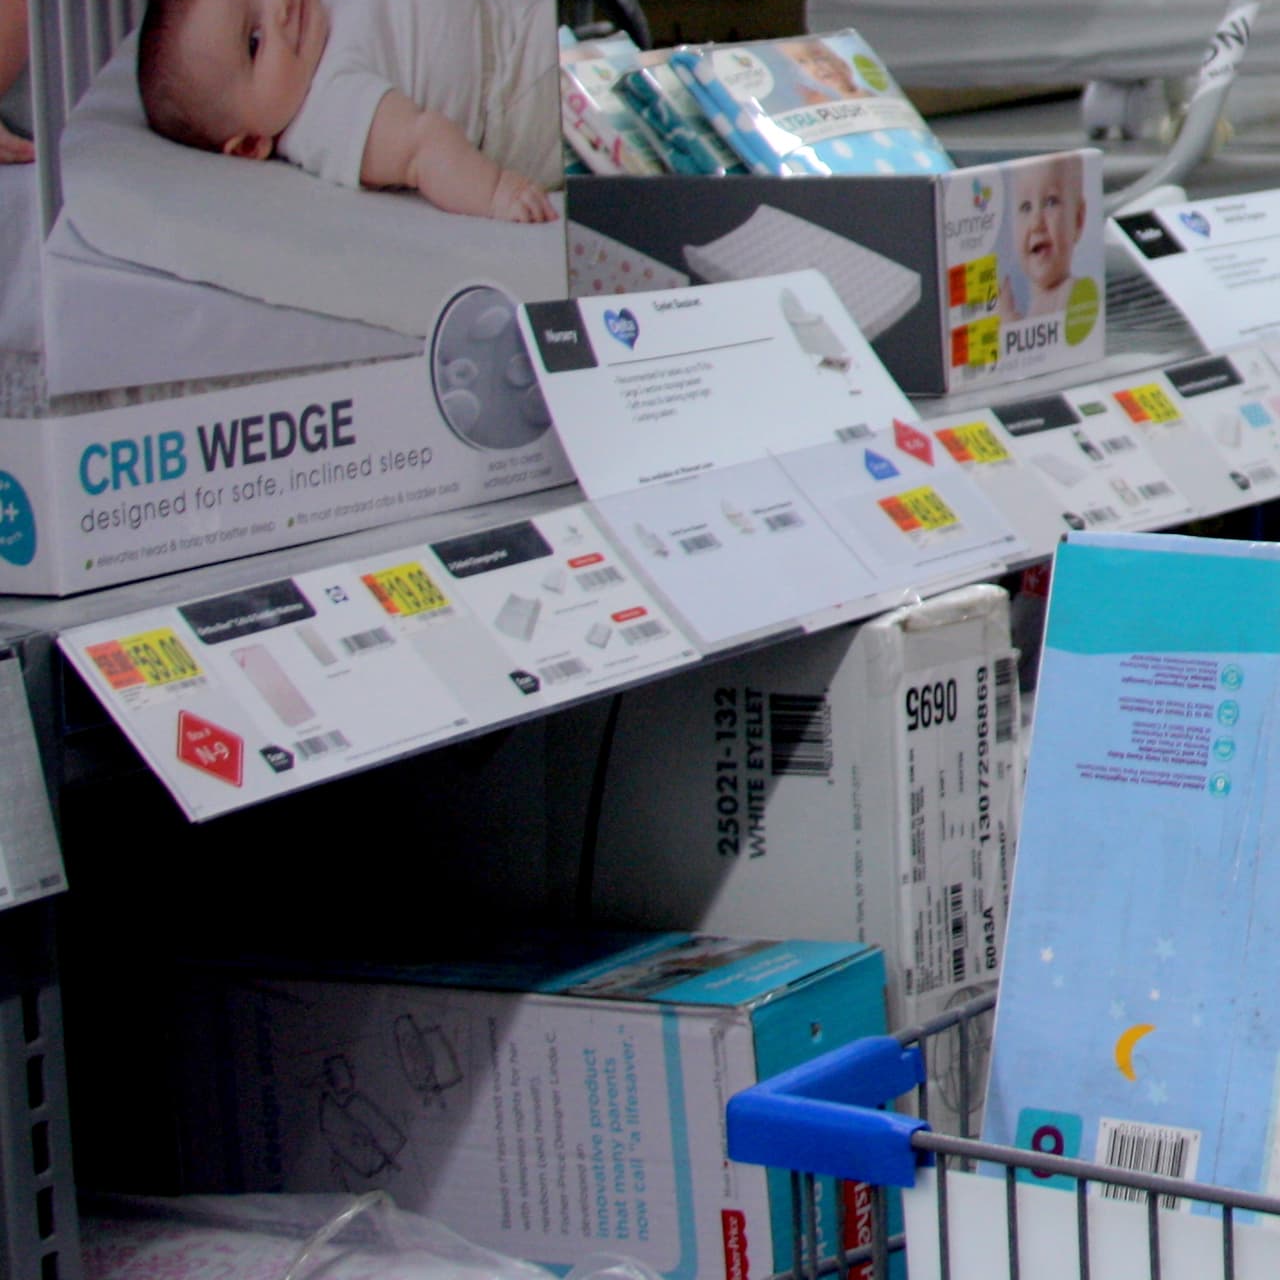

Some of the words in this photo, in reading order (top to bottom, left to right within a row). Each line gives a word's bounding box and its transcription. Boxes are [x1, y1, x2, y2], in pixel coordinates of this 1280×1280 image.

[816, 103, 863, 121] PLUSH
[945, 212, 995, 238] summer
[1005, 321, 1059, 355] PLUSH
[79, 431, 188, 497] CRIB
[197, 399, 357, 473] WEDGE
[80, 490, 188, 534] designed
[195, 483, 225, 510] for
[231, 475, 286, 505] safe,
[289, 453, 373, 491] inclined
[378, 445, 435, 475] sleep
[745, 687, 765, 769] EYELET
[905, 677, 958, 732] 0695
[714, 686, 741, 857] 25021-132
[976, 665, 993, 847] 1307296869
[746, 779, 767, 860] WHITE
[984, 905, 997, 971] 6043A
[548, 1046, 560, 1086] Linda
[582, 1047, 603, 1129] product
[604, 1056, 624, 1133] parents
[552, 1089, 565, 1151] Designer
[576, 1142, 586, 1161] an
[591, 1134, 610, 1239] innovative
[611, 1139, 626, 1194] many
[629, 1157, 647, 1193] call
[576, 1163, 591, 1239] developed
[615, 1199, 630, 1241] that
[636, 1199, 650, 1242] now
